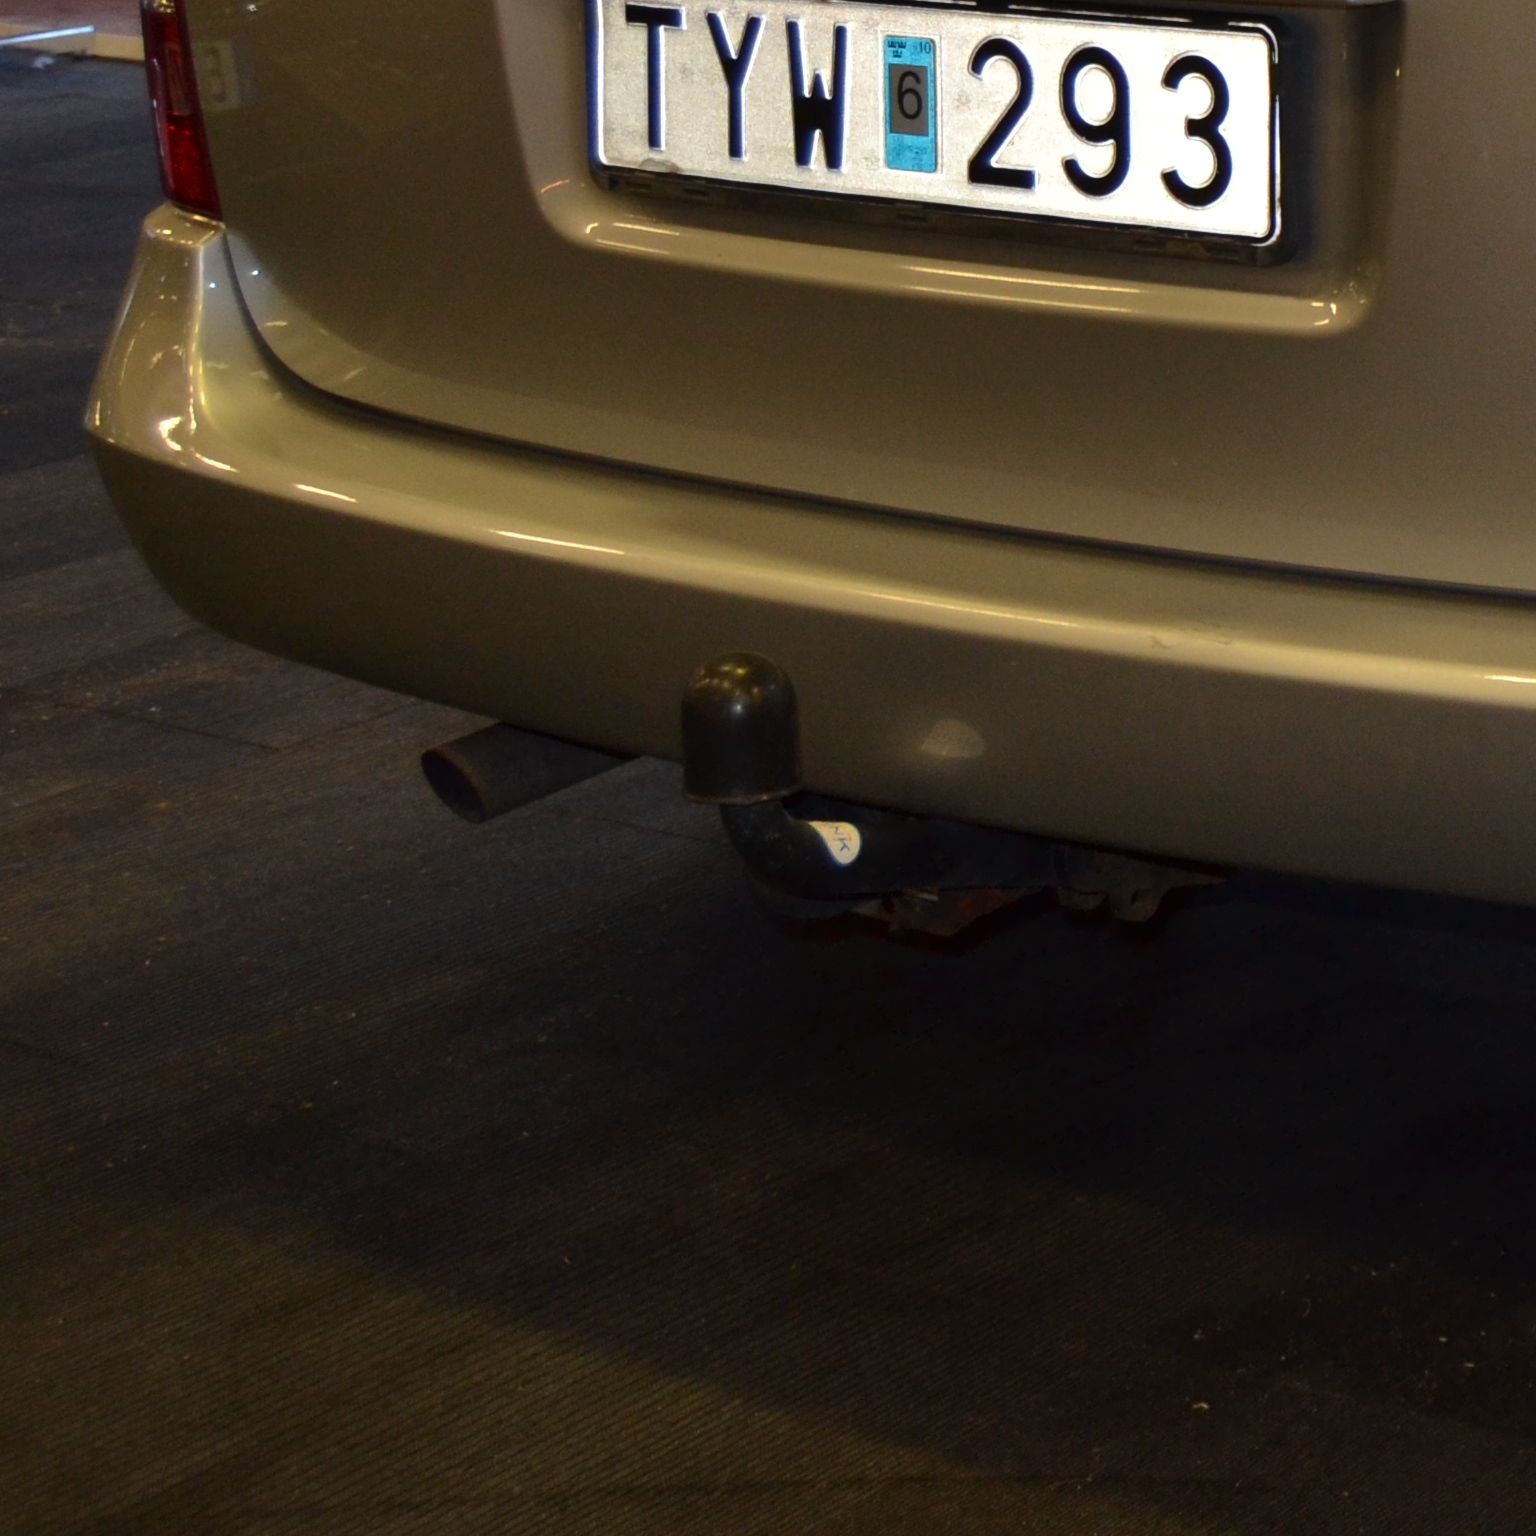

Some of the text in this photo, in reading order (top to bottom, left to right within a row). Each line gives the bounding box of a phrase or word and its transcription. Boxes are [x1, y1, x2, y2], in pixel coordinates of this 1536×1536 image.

[625, 0, 1234, 210] TYW 293
[896, 69, 923, 121] 6
